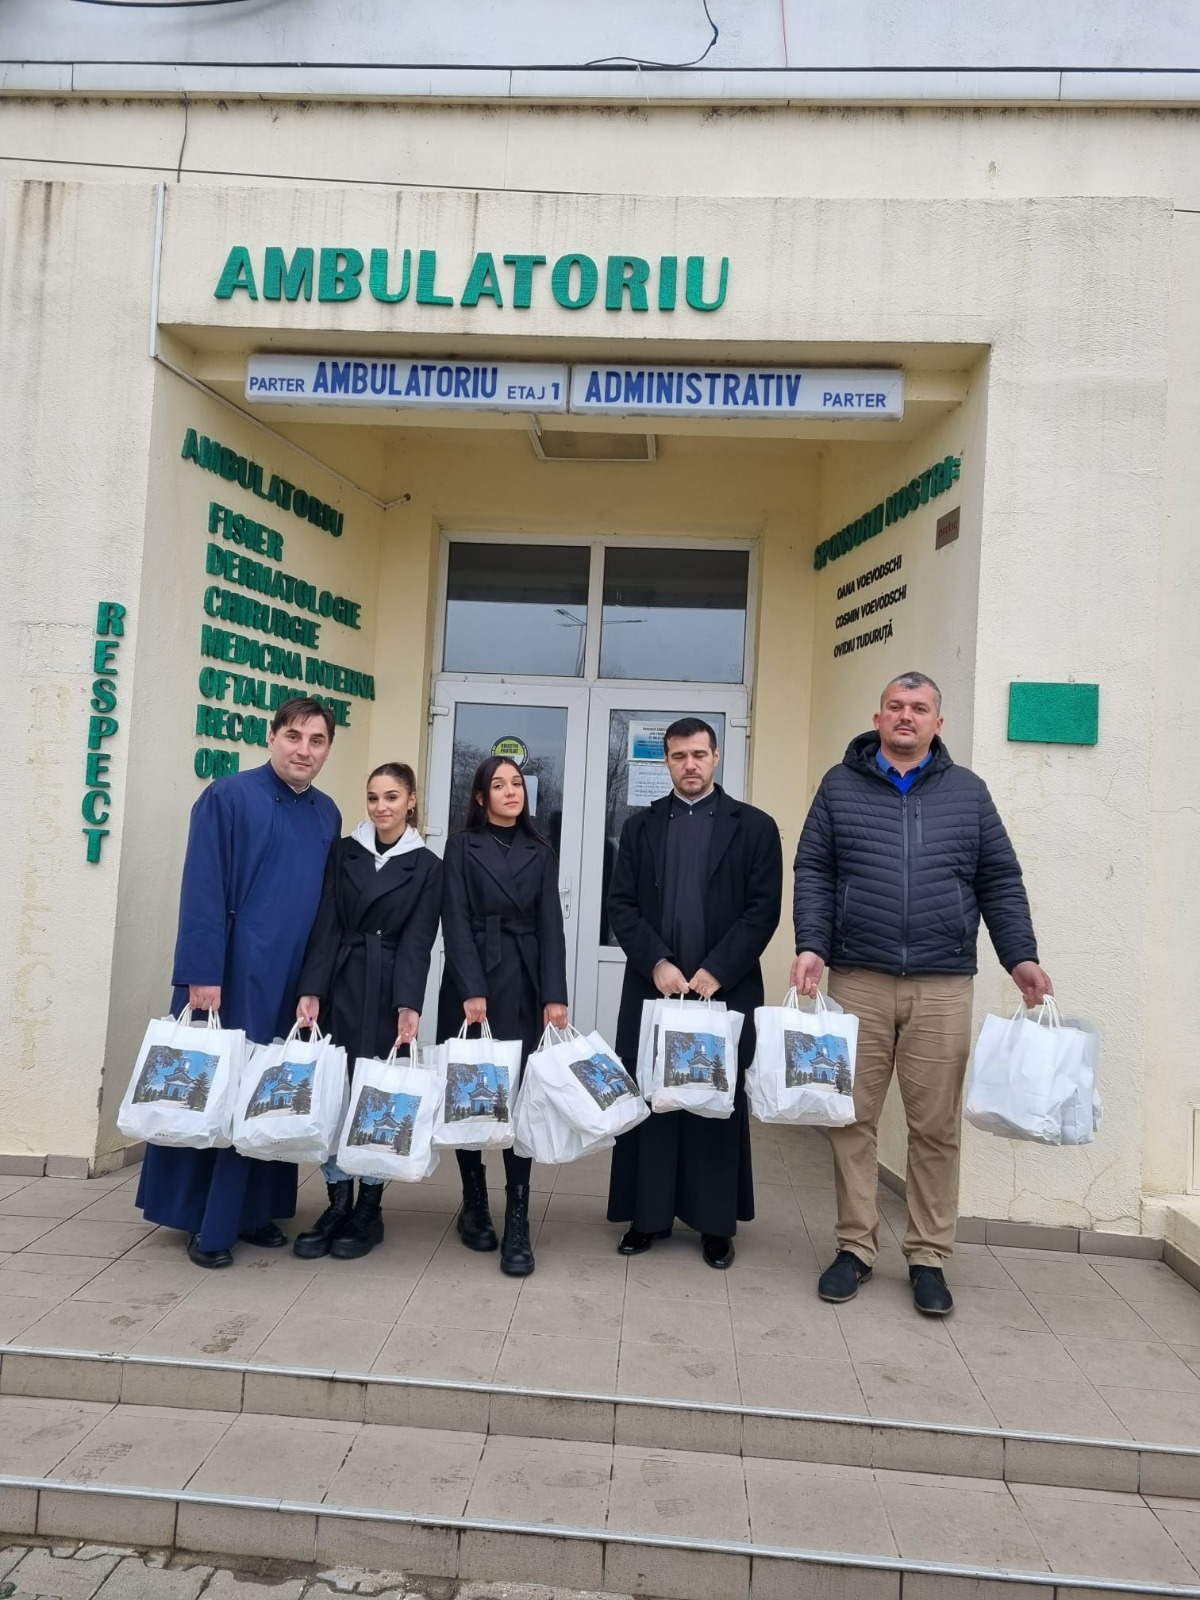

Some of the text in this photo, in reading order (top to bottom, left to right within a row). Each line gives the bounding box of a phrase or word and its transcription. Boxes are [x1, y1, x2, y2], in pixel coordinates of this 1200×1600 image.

[214, 246, 729, 312] AMBULATORIU
[250, 361, 560, 401] PARTER AMBULATORIU ETAJ 1
[584, 371, 887, 408] ADMINISTRATIV PARTER
[181, 428, 344, 537] AMBULATORIU
[814, 503, 884, 571] SPONSORII
[206, 543, 361, 630] DERMATOLOGIE
[835, 584, 907, 630] COSMIN VOEVODSCHI
[836, 554, 902, 600] OANA VOEVODSCHI
[204, 586, 321, 649] CHIRURGIE
[834, 638, 855, 658] OVIDIU
[201, 624, 376, 701] MEDICINA INTERNA
[82, 601, 127, 864] RESPECT
[196, 704, 275, 748] RECOL
